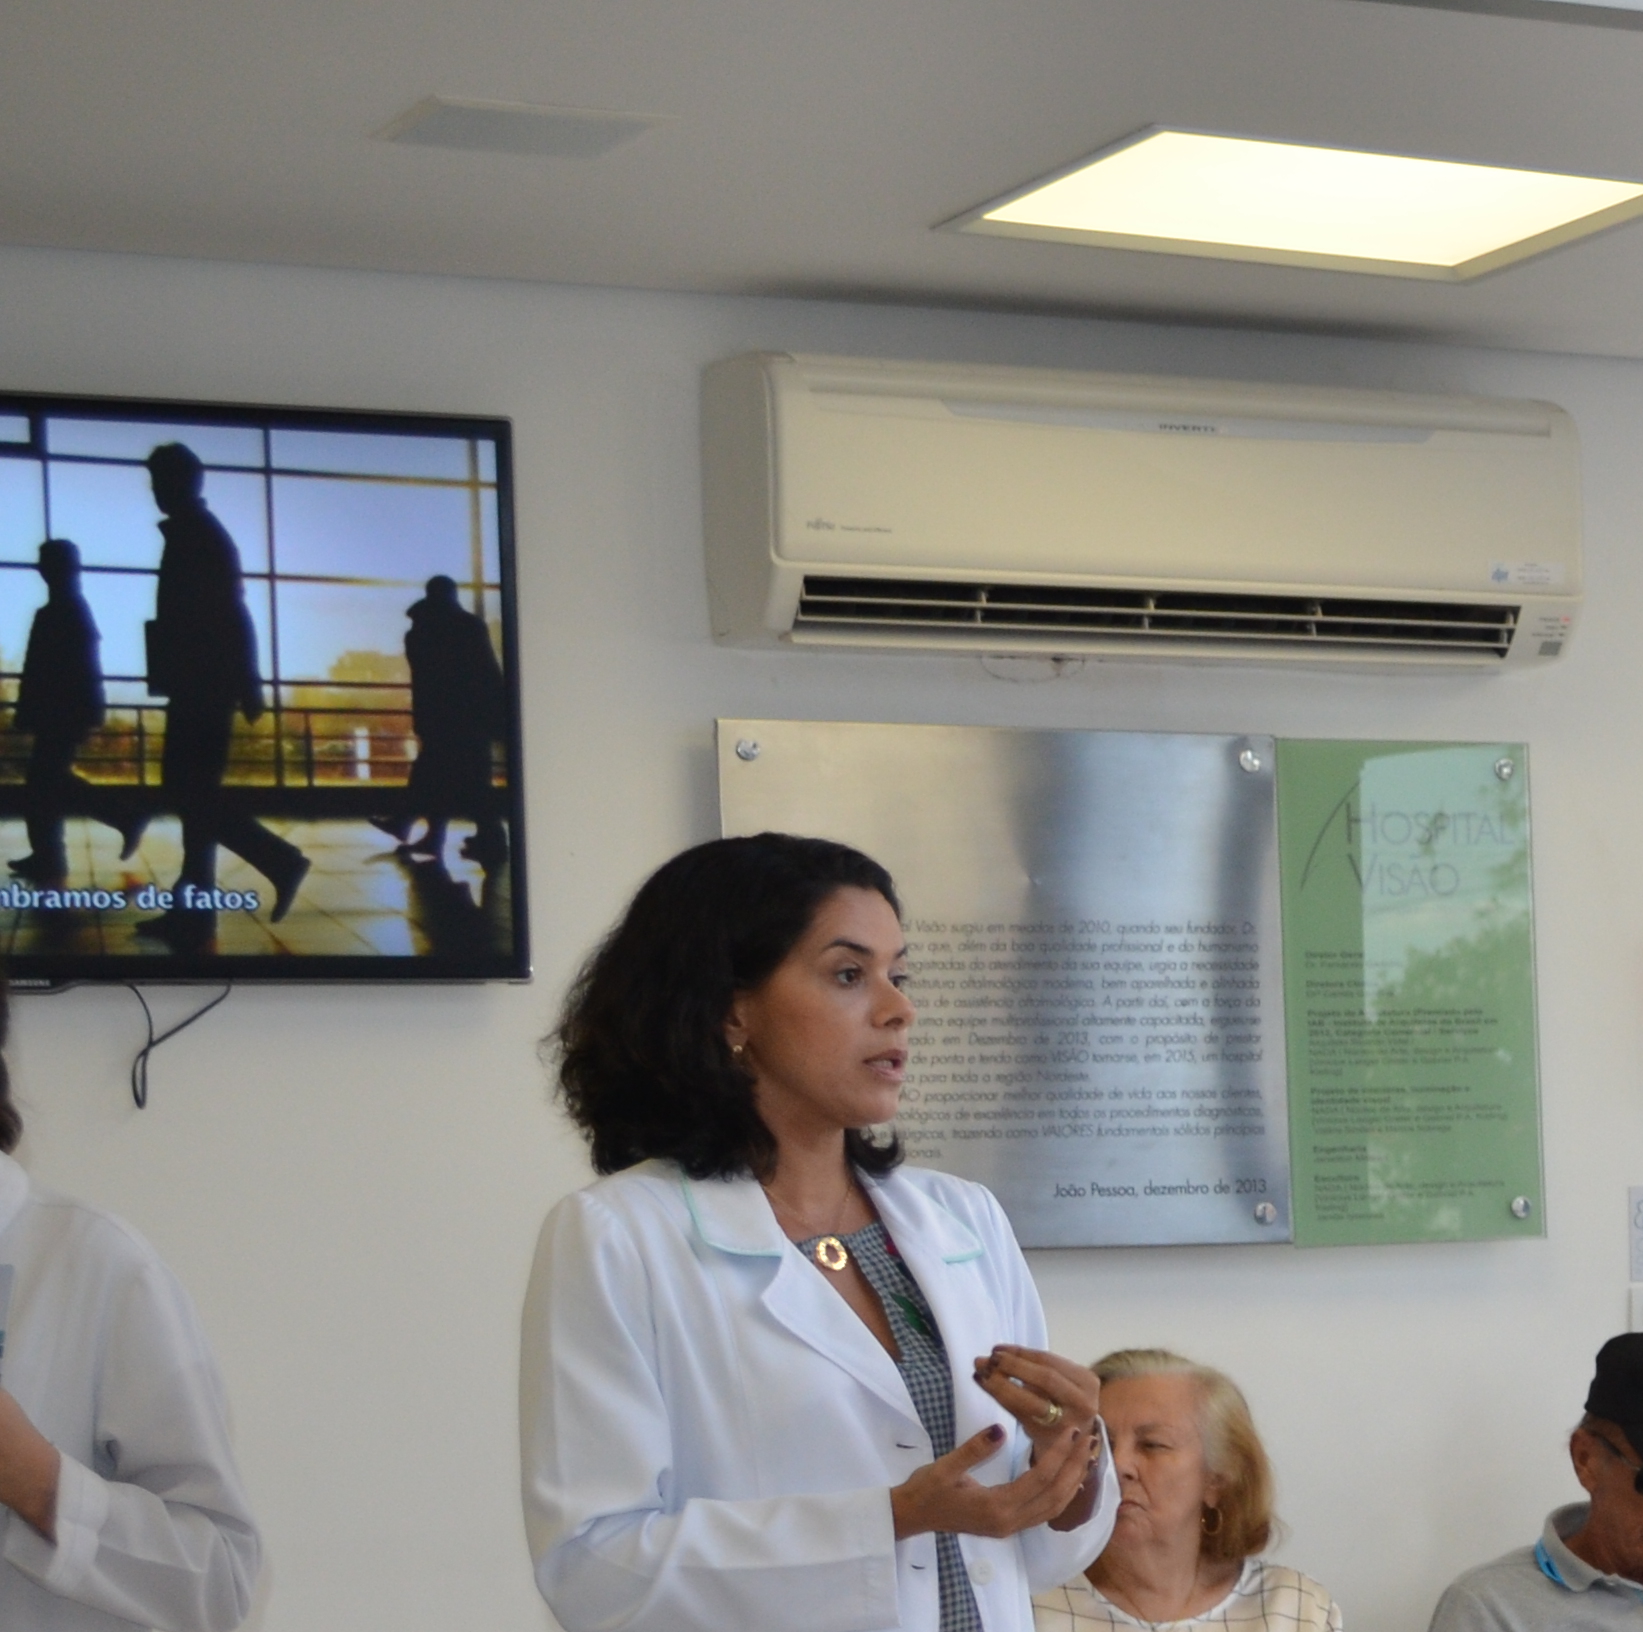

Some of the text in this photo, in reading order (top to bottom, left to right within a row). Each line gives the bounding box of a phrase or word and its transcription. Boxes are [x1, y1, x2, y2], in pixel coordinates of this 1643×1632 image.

[1345, 800, 1515, 846] HOSPITAL
[1348, 852, 1459, 897] VISÃO
[136, 883, 174, 909] de
[183, 884, 260, 911] fatos
[1053, 1179, 1267, 1198] João Pessoa, dezembro de 2013
